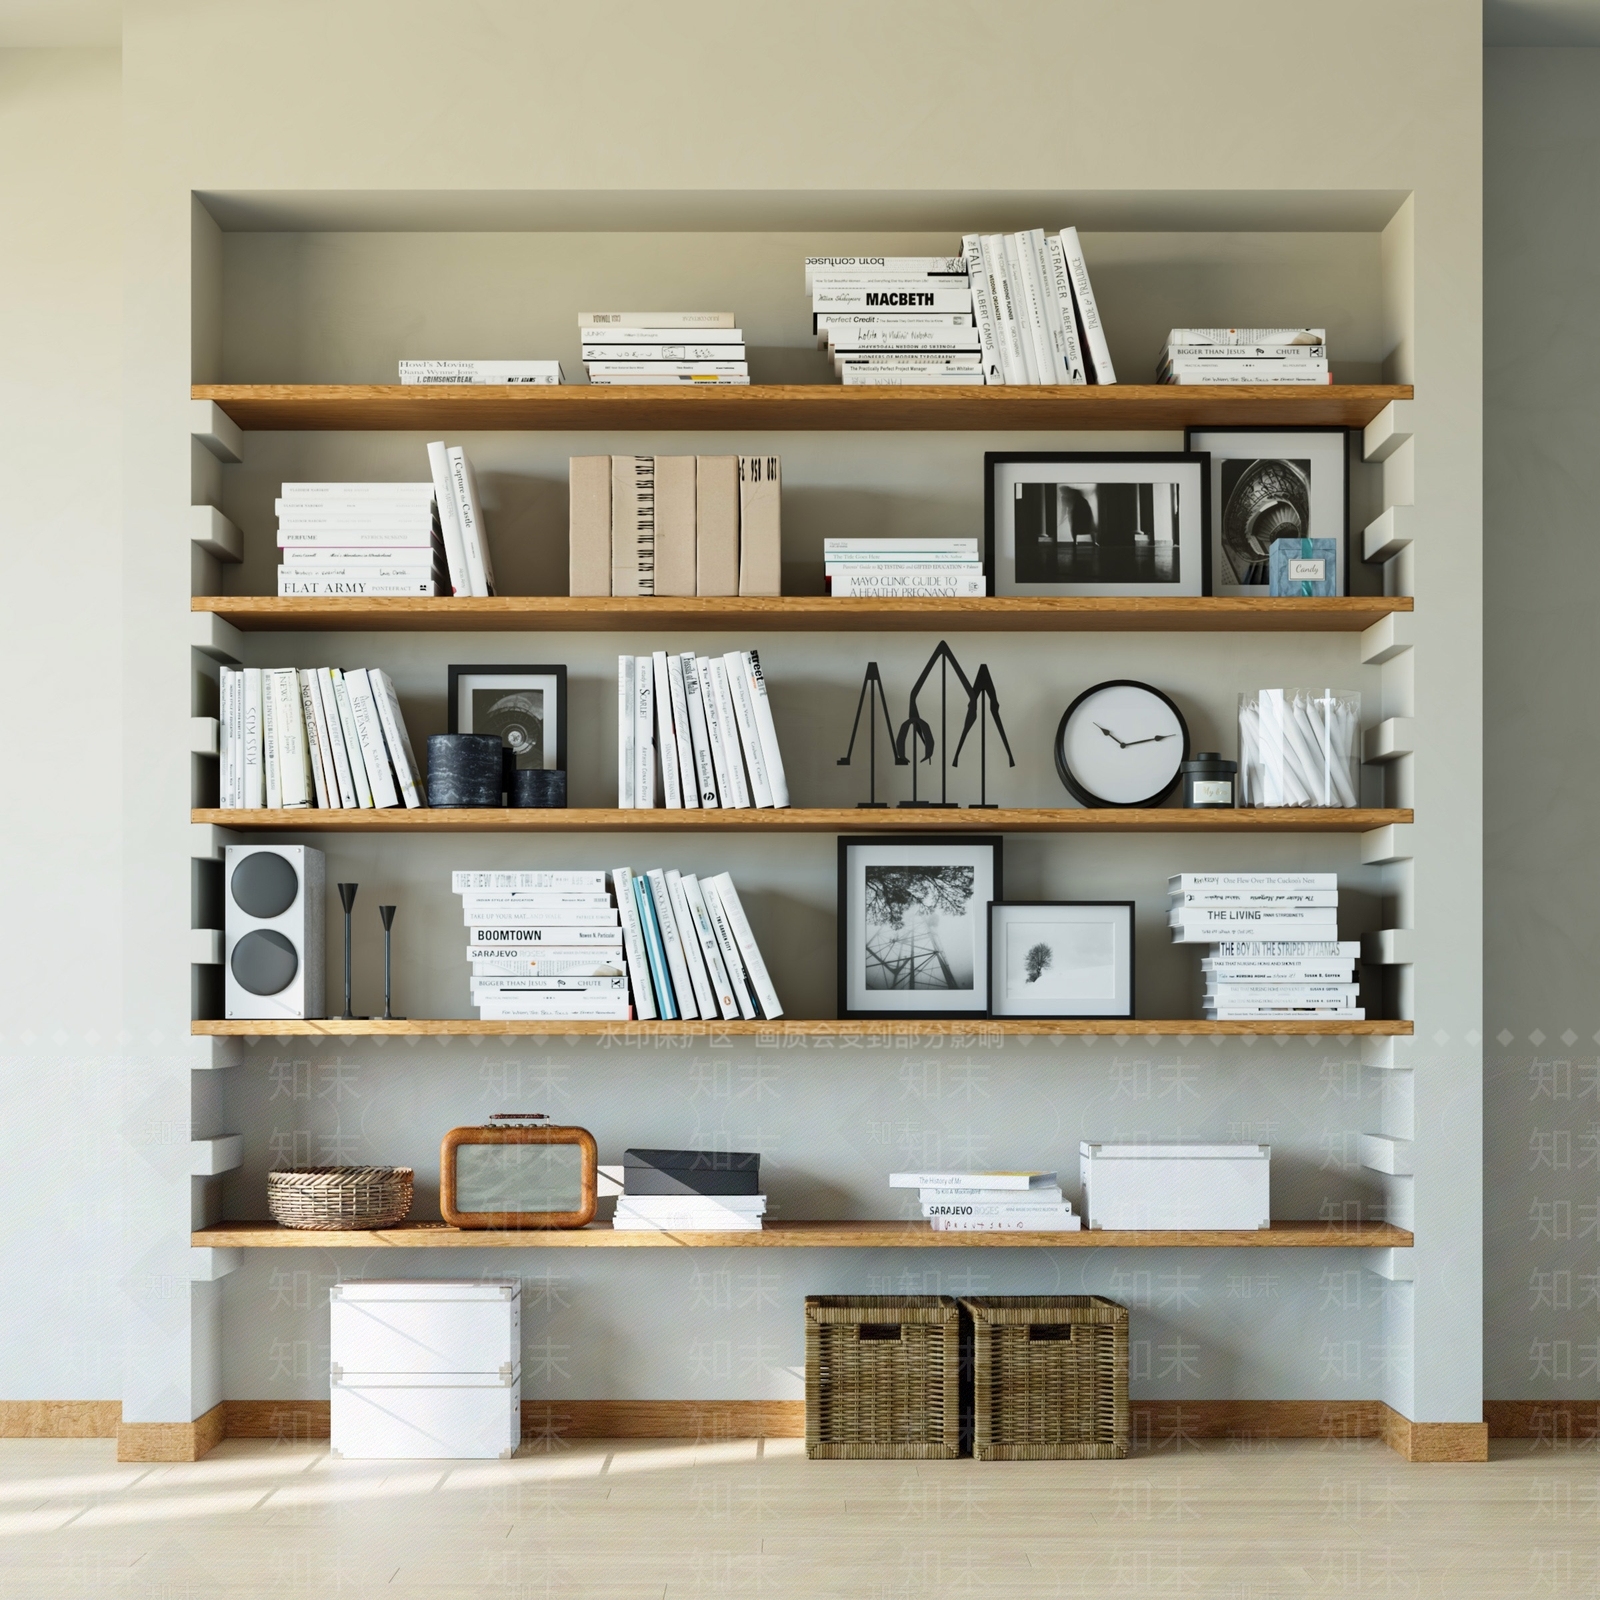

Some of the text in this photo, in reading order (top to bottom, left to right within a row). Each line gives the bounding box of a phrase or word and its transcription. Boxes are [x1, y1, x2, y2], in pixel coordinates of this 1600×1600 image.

[969, 248, 982, 277] FALL
[1051, 245, 1067, 299] STRANGER
[866, 293, 934, 305] MACBETH
[989, 274, 1001, 321] WEDDING ORGANIZER
[1072, 257, 1099, 330] PRIDE PREJUDICE
[977, 290, 994, 350] ALBERT CAMUS
[1006, 301, 1014, 321] PLANNER
[857, 328, 877, 341] Lolita
[1062, 307, 1078, 362] ALBERT CAMUS
[437, 361, 474, 369] Moving
[454, 462, 471, 528] Capture Castle
[851, 577, 957, 586] MAYO CLINIC GUIDE TO
[1296, 564, 1318, 574] Candy
[284, 583, 367, 594] FLAT ARMY
[850, 588, 957, 597] A HEALTHY PREGNANCY
[265, 675, 273, 700] BEYOND
[684, 657, 699, 695] Fossils Malta
[335, 683, 344, 702] Tales
[640, 689, 650, 719] SCARLET
[302, 685, 316, 746] Not Quite Cricket
[705, 682, 713, 702] Prince
[711, 721, 719, 743] Pauper
[247, 707, 257, 765] KISS KISS
[330, 713, 340, 747] INFLUENCE
[456, 873, 517, 888] THE NEW YORK
[654, 877, 665, 904] UNLOCK
[663, 921, 674, 943] DOOR
[1208, 911, 1261, 919] THE LIVING
[478, 930, 542, 941] BOOMTOWN
[718, 924, 728, 940] GARDEN
[723, 940, 731, 951] CITY
[1221, 943, 1340, 956] THE BOY IN THE STRIPED PYJAMAS
[929, 1206, 973, 1215] SARAJEVO
